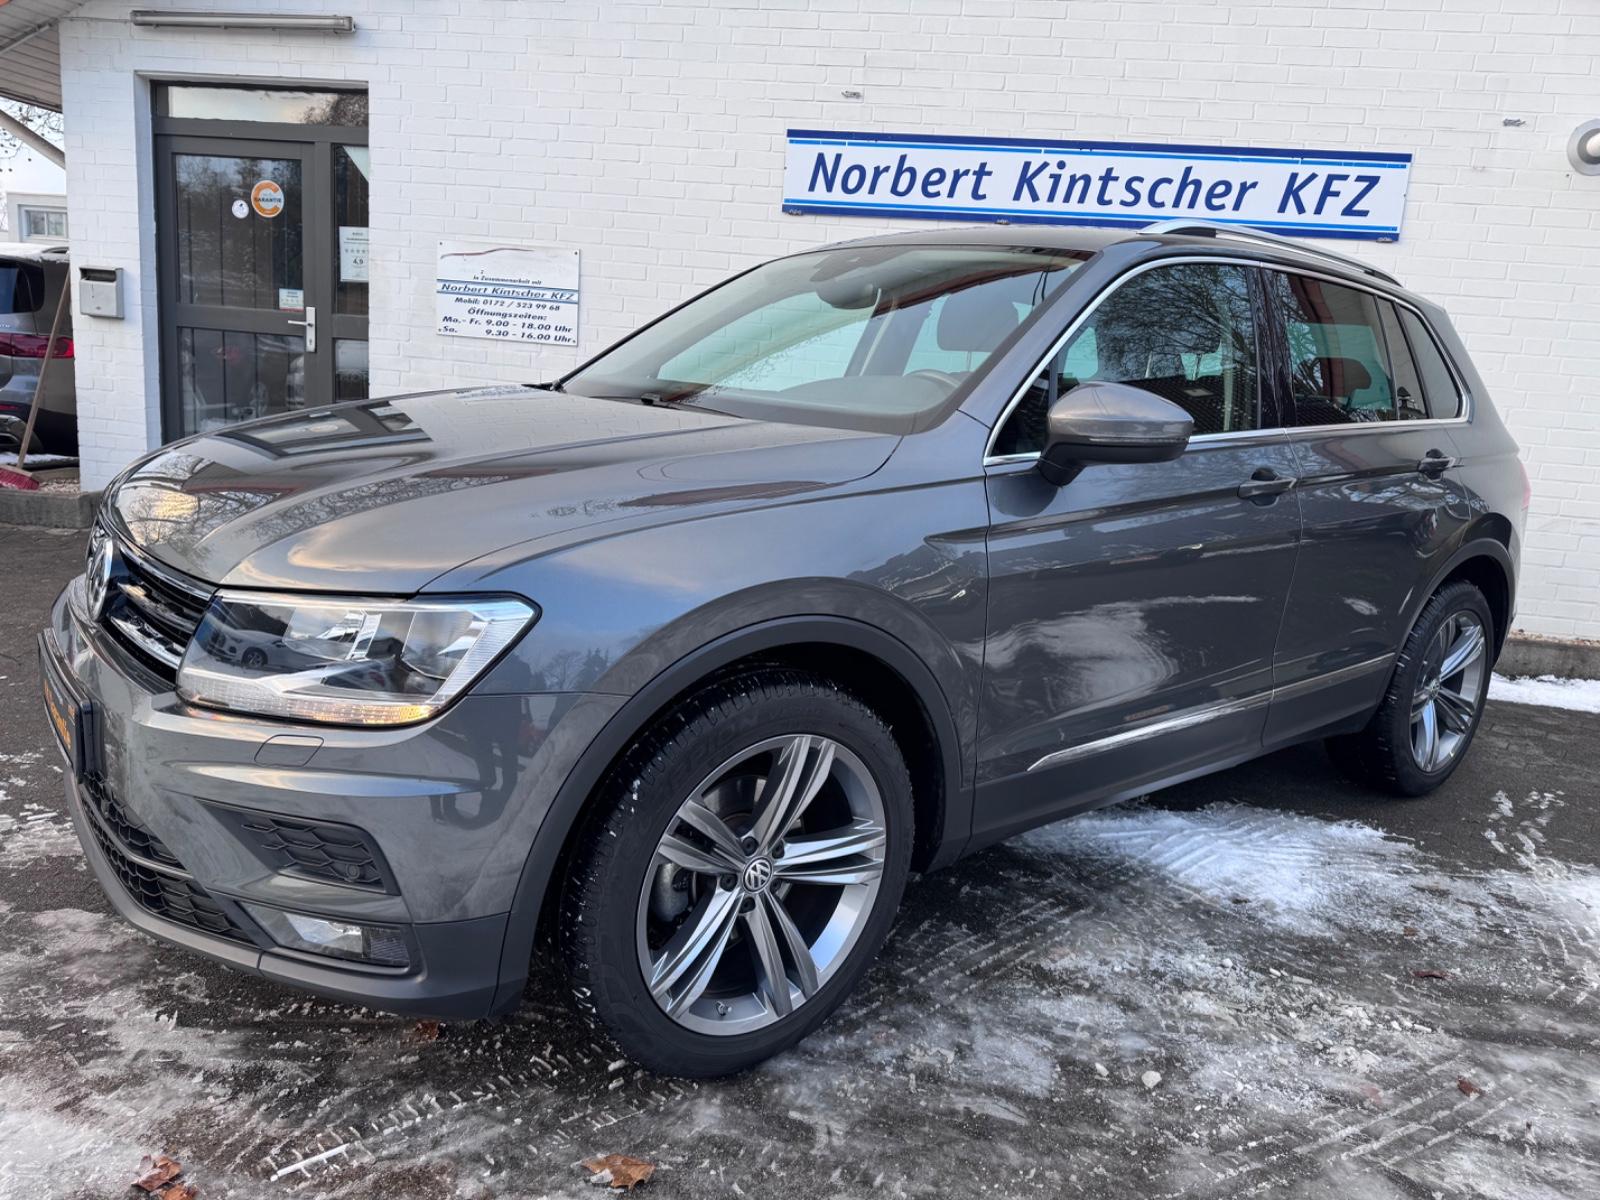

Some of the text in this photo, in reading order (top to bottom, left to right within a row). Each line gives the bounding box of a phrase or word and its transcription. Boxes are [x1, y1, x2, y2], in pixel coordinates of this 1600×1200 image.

[807, 152, 1381, 217] Norbert Kintscher KFZ
[441, 283, 575, 300] Norbert Kintscher KFZ
[467, 306, 548, 321] Öffnungszeiten:
[485, 319, 509, 327] 9.00
[521, 322, 551, 331] 18.00
[554, 324, 573, 333] Uhr
[485, 329, 509, 337] 9.30
[521, 332, 551, 341] 16.00
